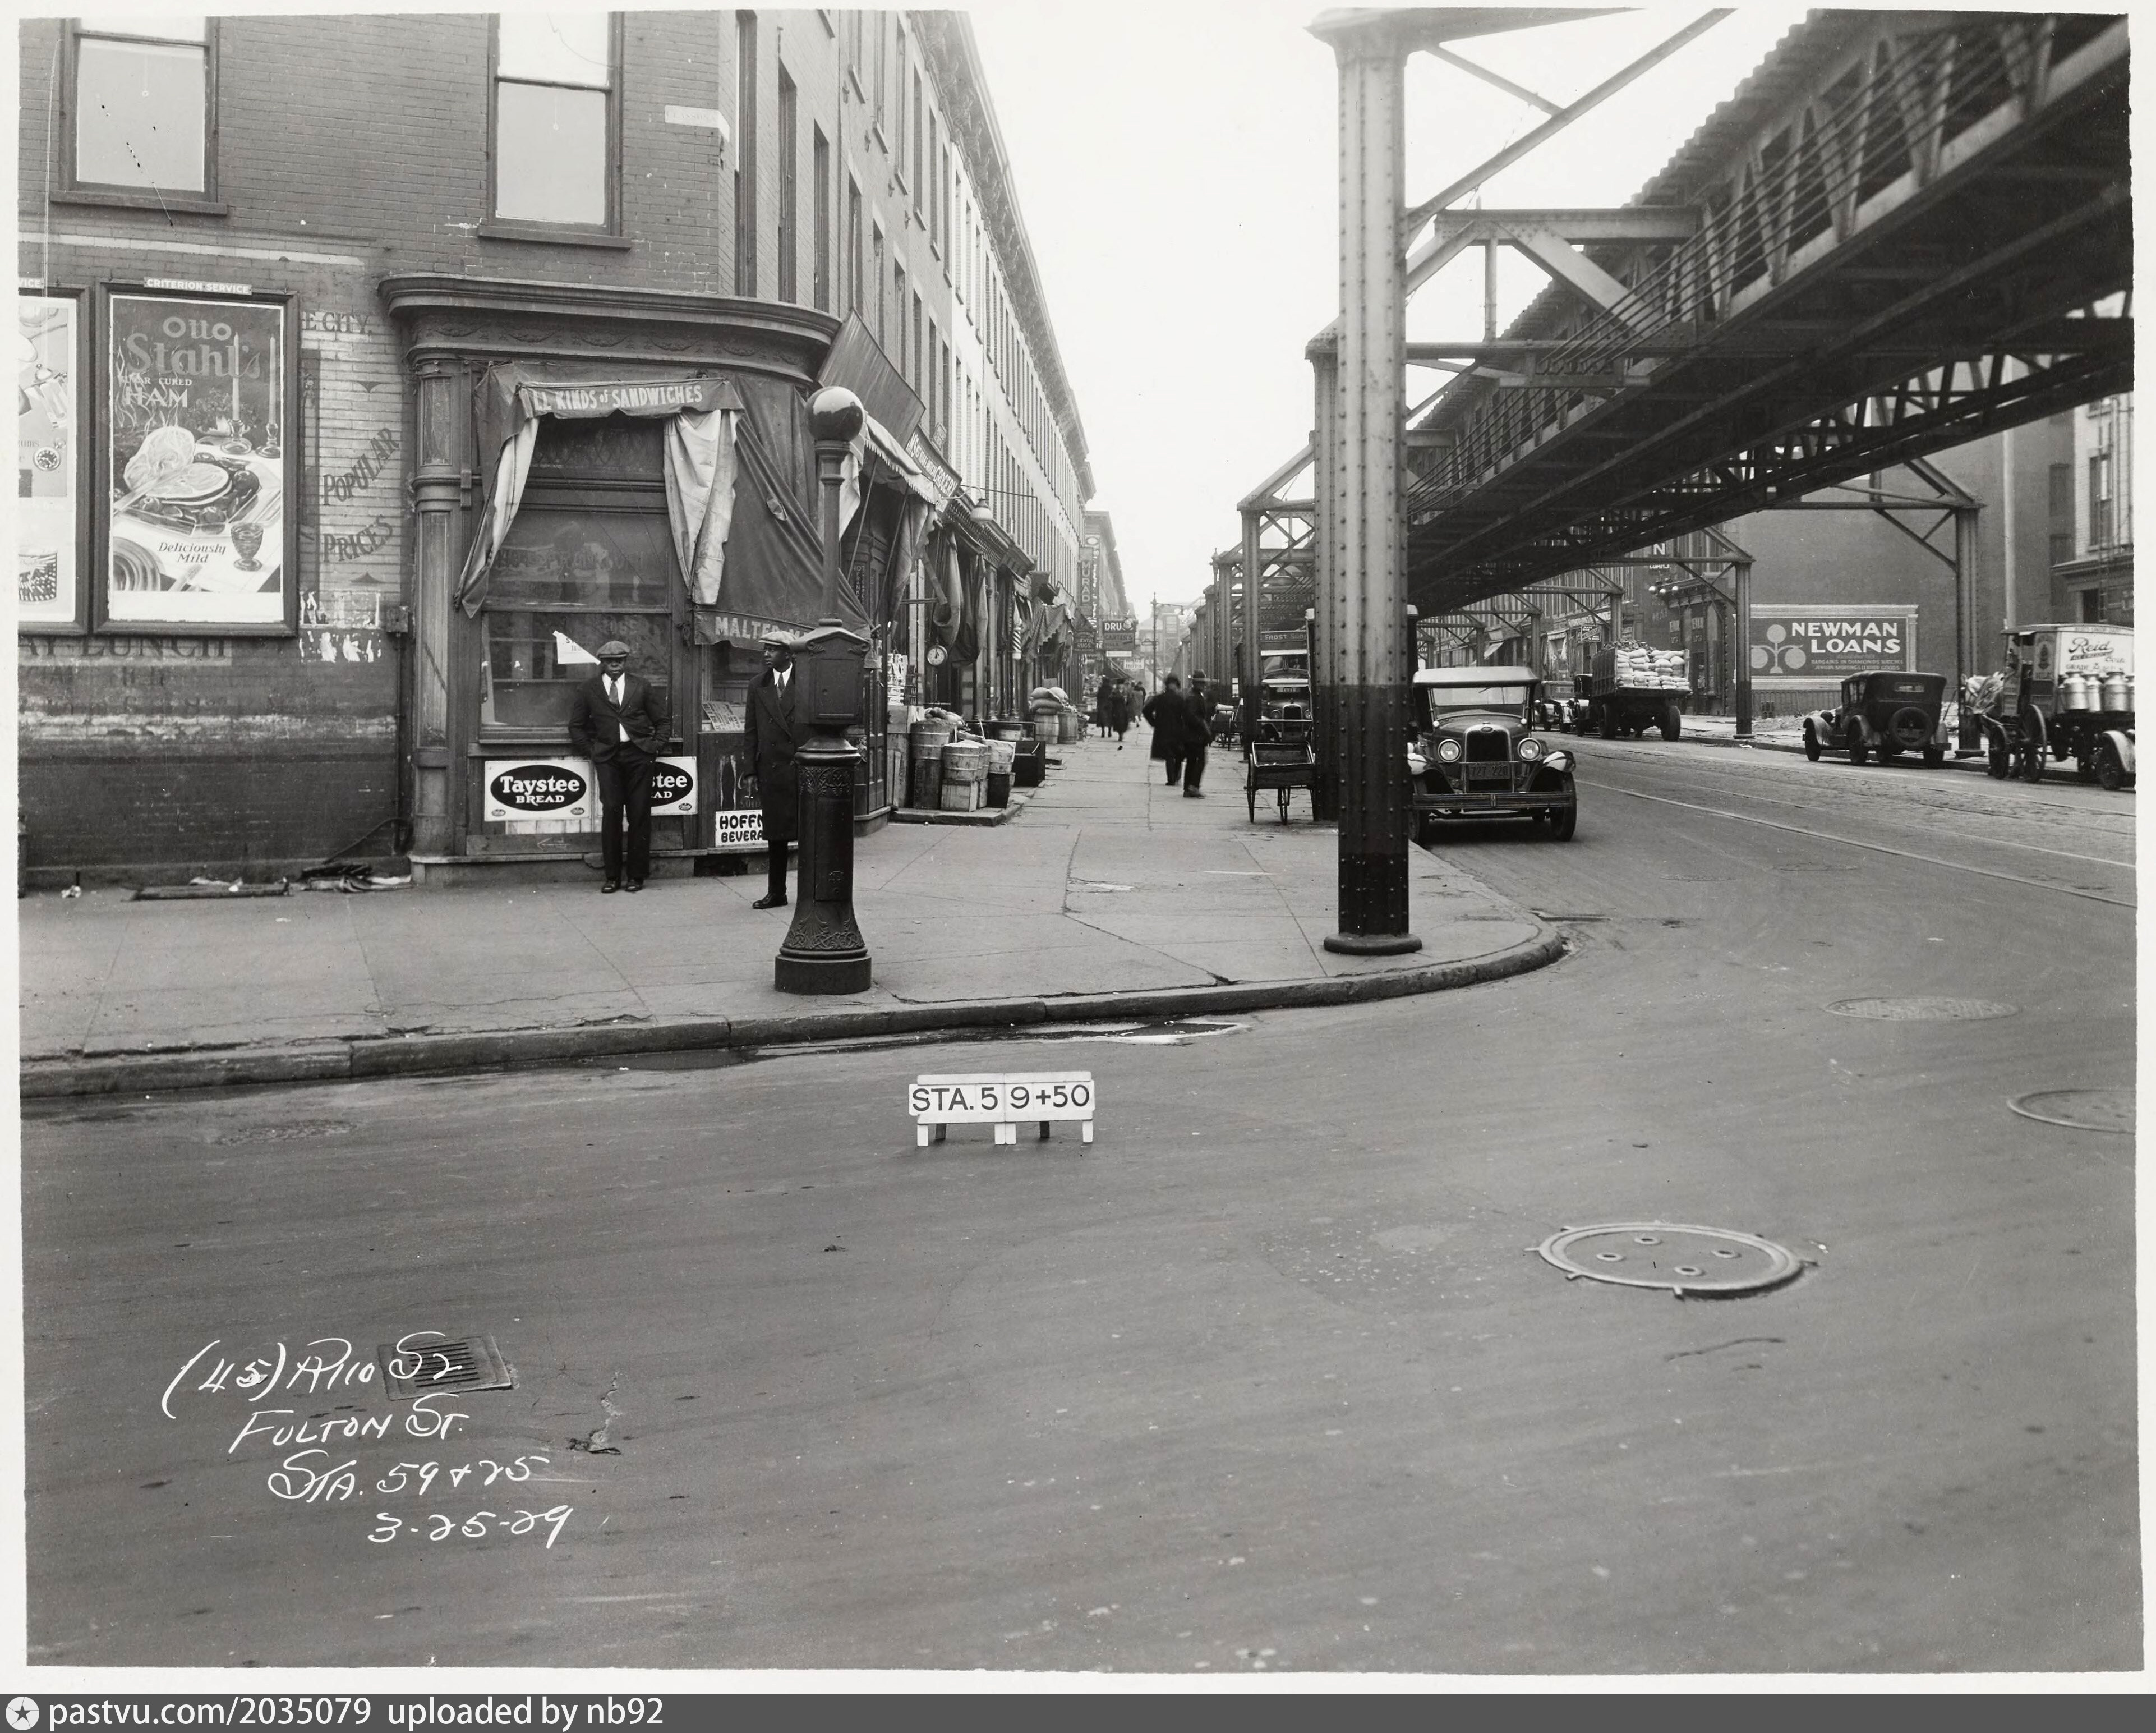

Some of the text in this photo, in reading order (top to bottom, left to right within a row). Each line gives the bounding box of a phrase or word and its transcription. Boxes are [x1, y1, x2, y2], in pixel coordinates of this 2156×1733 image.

[146, 279, 250, 293] CRITERION SERVICE
[162, 316, 232, 341] Otto
[126, 332, 261, 379] Stahl's
[125, 385, 188, 408] HAM
[555, 390, 598, 410] KINDS
[599, 389, 608, 403] of
[611, 385, 703, 408] SANDWICHES
[323, 427, 400, 506] POPULAR
[158, 541, 227, 555] Deliciously
[323, 514, 393, 563] PRICES
[177, 553, 209, 564] Mild
[1081, 562, 1091, 603] MURAD
[1104, 622, 1134, 631] DRU
[1791, 622, 1897, 637] NEWMAN
[1811, 638, 1901, 654] LOANS
[2068, 636, 2114, 654] Reid
[500, 775, 580, 796] Taystee
[515, 795, 565, 806] BREAD
[913, 1088, 974, 1111] STA.
